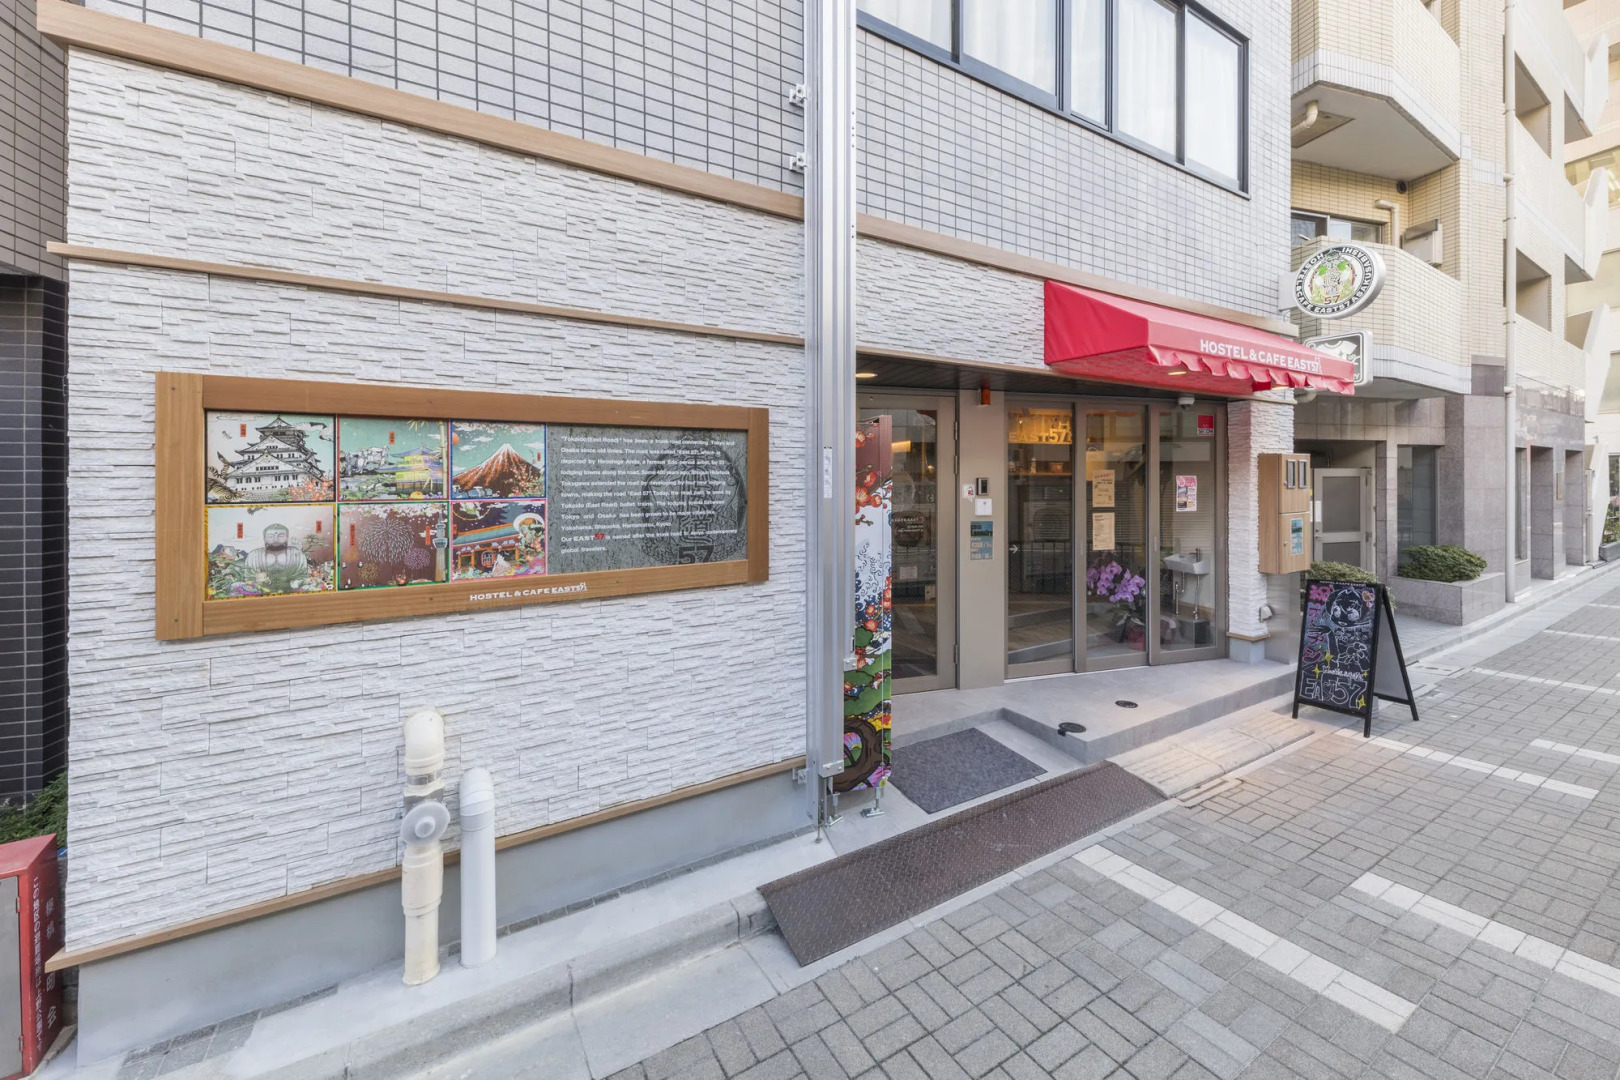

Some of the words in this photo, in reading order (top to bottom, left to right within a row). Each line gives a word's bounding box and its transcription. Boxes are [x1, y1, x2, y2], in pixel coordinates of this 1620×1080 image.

[1296, 253, 1324, 285] HOSTEL
[1296, 292, 1313, 310] CAFE
[1324, 295, 1340, 304] 57
[1314, 301, 1350, 313] EAST57
[1200, 339, 1249, 360] HOSTEL
[1250, 349, 1257, 361] &
[1258, 350, 1286, 366] CAFE
[1288, 357, 1319, 372] EAST57
[1009, 428, 1067, 442] EAST57
[573, 533, 605, 541] EAST57
[679, 546, 714, 564] 57
[469, 592, 513, 601] HOSTEL
